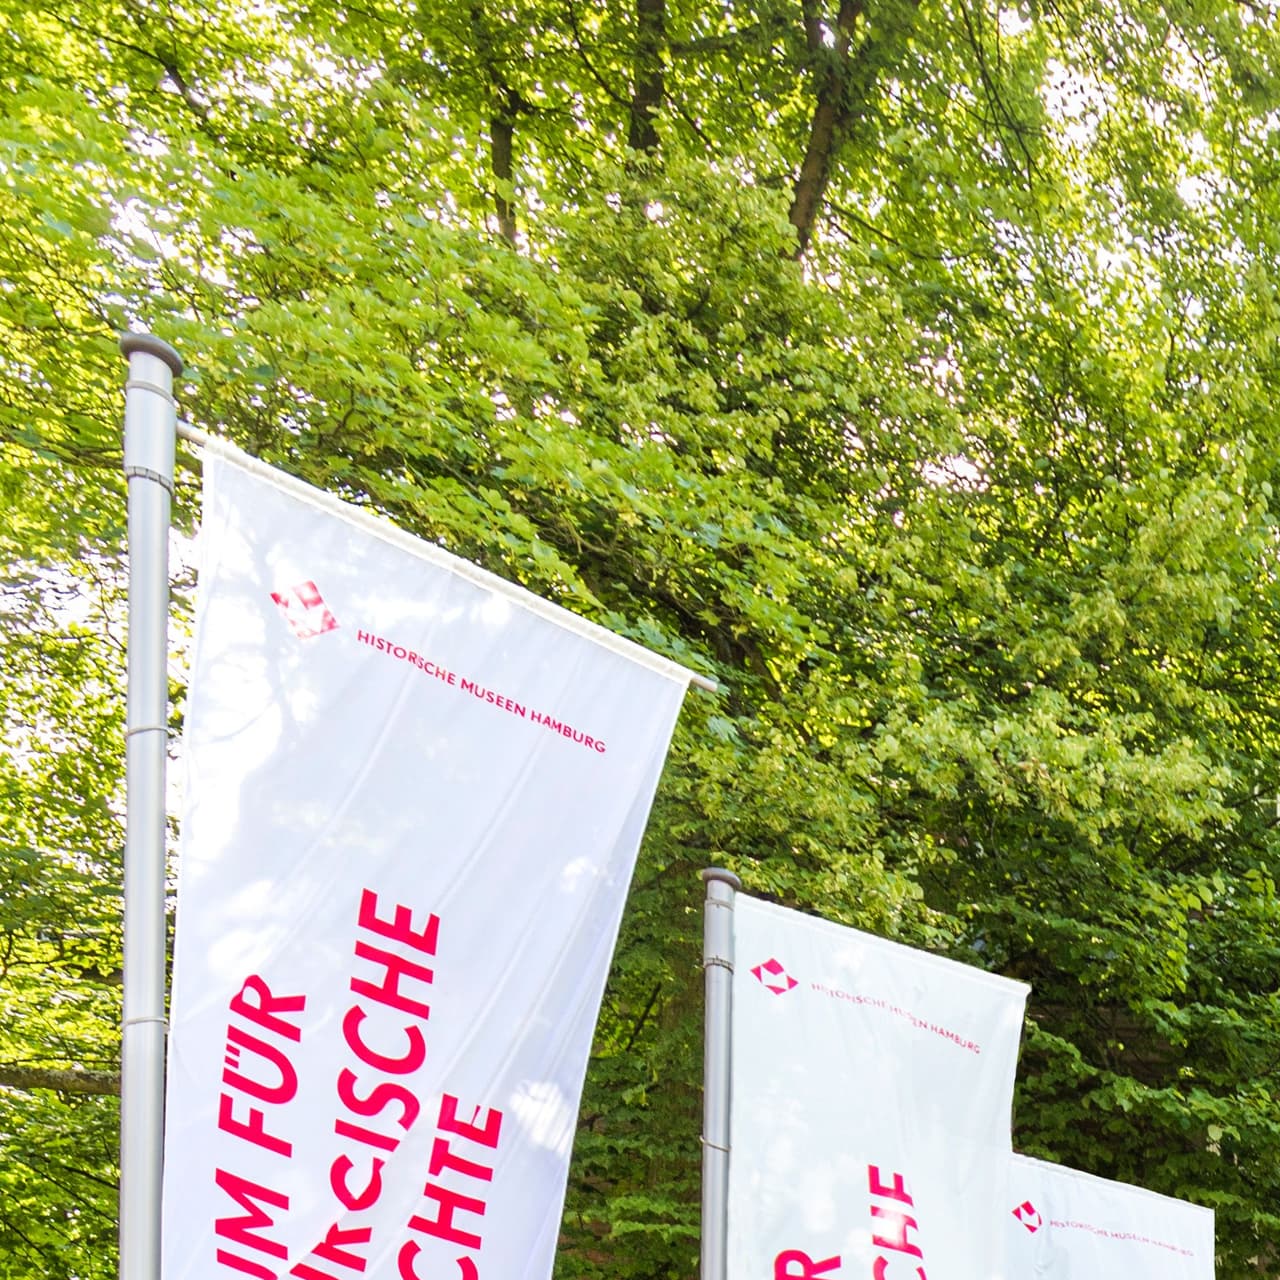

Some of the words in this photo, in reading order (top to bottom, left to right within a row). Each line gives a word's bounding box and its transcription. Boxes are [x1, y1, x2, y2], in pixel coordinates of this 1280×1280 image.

[357, 630, 457, 686] HISTORSCHE
[461, 678, 527, 719] MUSEEN
[530, 711, 606, 754] HAMBURG
[218, 974, 307, 1159] FÜR
